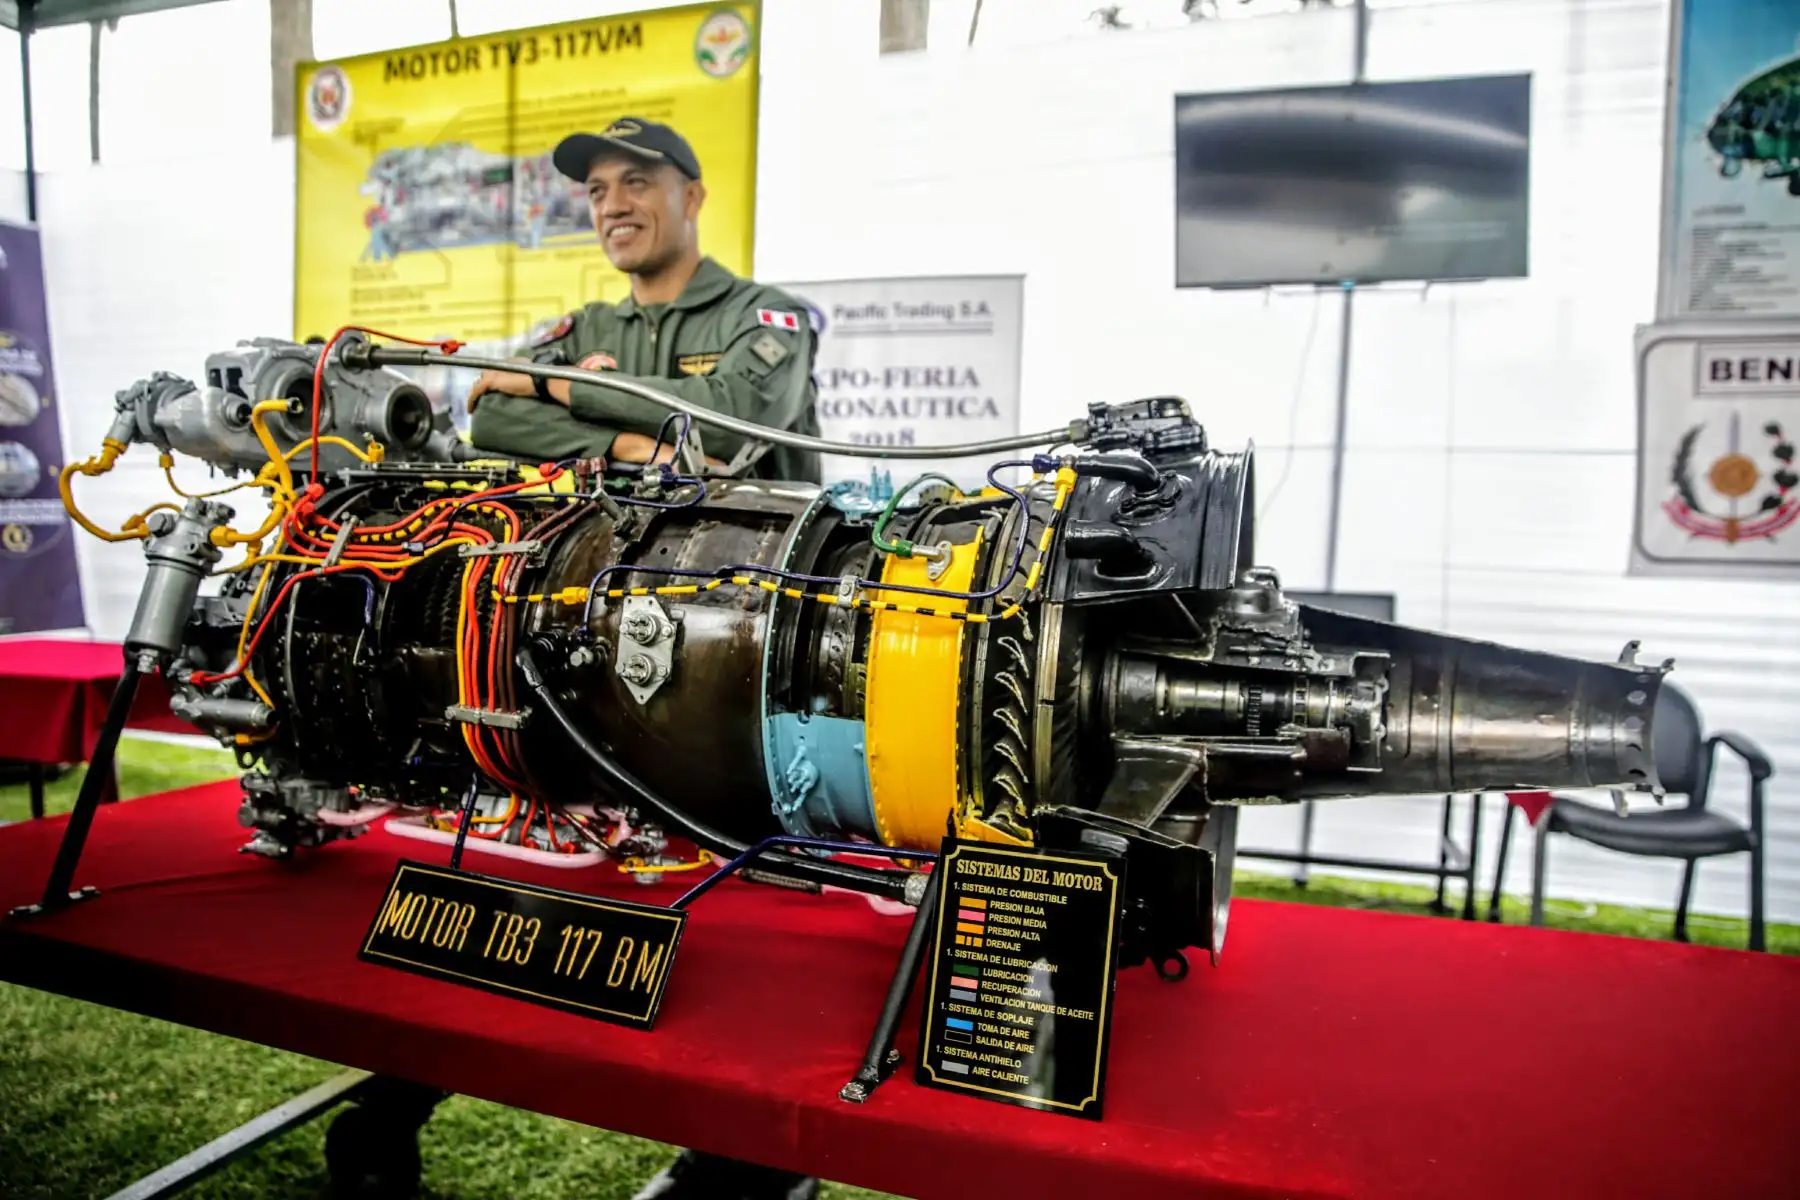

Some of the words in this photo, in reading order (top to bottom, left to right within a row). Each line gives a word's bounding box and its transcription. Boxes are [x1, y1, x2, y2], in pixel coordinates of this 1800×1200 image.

[384, 45, 483, 83] MOTOR
[489, 22, 644, 72] TV3-117VM
[834, 303, 887, 319] Pacific
[893, 302, 955, 322] Trading
[1710, 358, 1800, 381] BEN
[956, 859, 1021, 881] SISTEMAS
[1023, 868, 1049, 884] DEL
[1053, 872, 1103, 891] MOTOR
[954, 882, 960, 890] 1.
[962, 883, 995, 895] SISTEMA
[997, 888, 1008, 896] DE
[1009, 889, 1067, 904] COMBUSTIBLE
[990, 901, 1022, 912] PRESION
[1024, 905, 1045, 915] BAJA
[989, 914, 1021, 925] PRESION
[1023, 918, 1047, 928] MEDIA
[380, 890, 476, 952] MOTOR
[483, 911, 541, 965] TB3
[554, 924, 602, 980] 117
[606, 936, 664, 994] BM
[987, 926, 1019, 938] PRESION
[1020, 931, 1040, 941] ALTA
[986, 939, 1021, 951] DRENAJE
[947, 948, 953, 957] 1.
[955, 949, 988, 961] SISTEMA
[990, 955, 1000, 964] DE
[1002, 957, 1058, 972] LUBRICACION
[983, 968, 1034, 984] LUBRICACION
[982, 981, 1041, 997] RECUPERACION
[941, 1002, 947, 1010] 1.
[948, 1003, 982, 1016] SISTEMA
[984, 1009, 995, 1018] DE
[996, 1011, 1034, 1025] SOPLAJE
[980, 994, 1026, 1009] VENTILACION
[1027, 1001, 1055, 1014] TANQUE
[1057, 1005, 1067, 1015] DE
[1068, 1007, 1094, 1020] ACEITE
[977, 1023, 999, 1033] TOMA
[1000, 1027, 1010, 1036] DE
[1012, 1029, 1030, 1039] AIRE
[976, 1036, 1000, 1048] SALIDA
[1002, 1040, 1013, 1050] DE
[1015, 1043, 1034, 1053] AIRE
[936, 1045, 942, 1053] 1.
[944, 1046, 977, 1059] SISTEMA
[978, 1052, 1021, 1068] ANTIHIELO
[972, 1066, 990, 1077] AIRE
[992, 1069, 1029, 1084] CALIENTE
